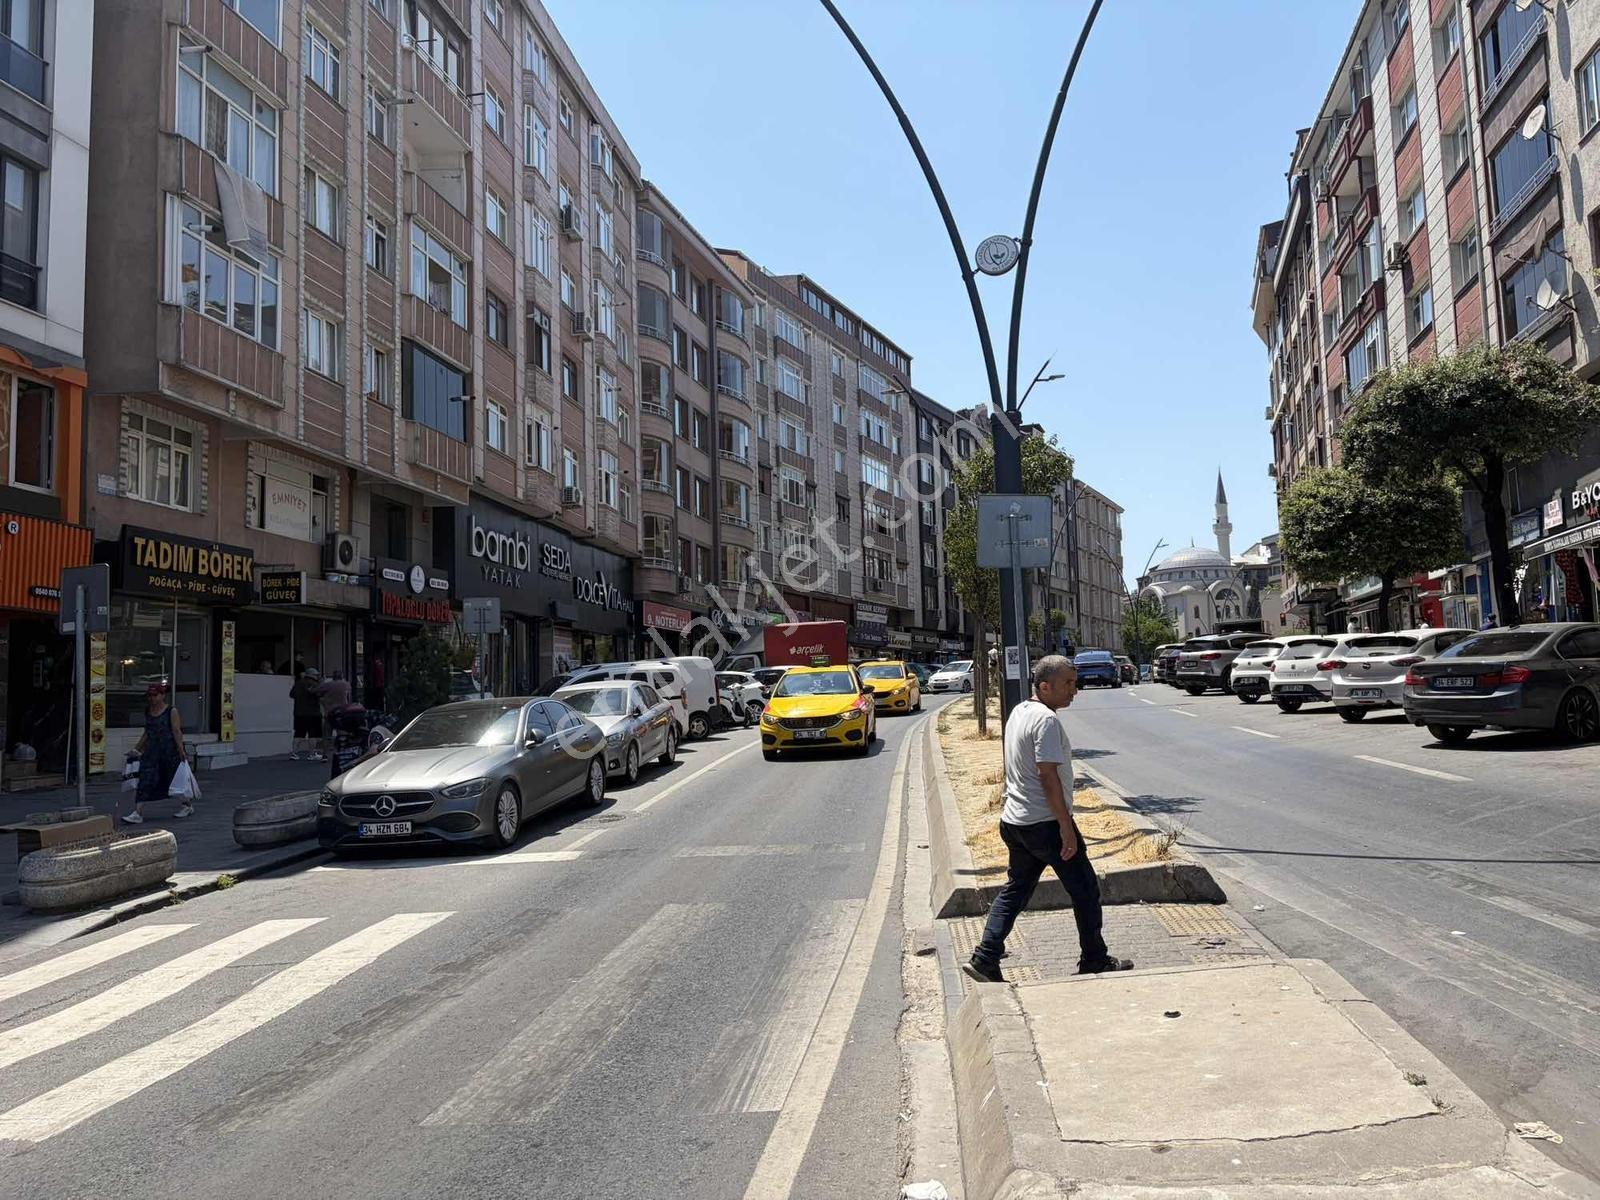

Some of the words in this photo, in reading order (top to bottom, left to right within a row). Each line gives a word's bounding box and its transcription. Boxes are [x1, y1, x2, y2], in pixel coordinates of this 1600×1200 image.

[472, 514, 531, 573] bambi
[134, 536, 193, 574] TADIM
[198, 544, 253, 582] BÖREK
[543, 543, 572, 574] SEDA
[149, 576, 182, 593] POĞAÇA
[188, 580, 206, 593] PİDE
[212, 584, 236, 597] GÜVEÇ
[483, 565, 521, 589] YATAK
[266, 588, 296, 601] GÜVEÇ
[796, 644, 824, 657] arçelik
[363, 825, 373, 834] 34
[394, 823, 409, 833] 684
